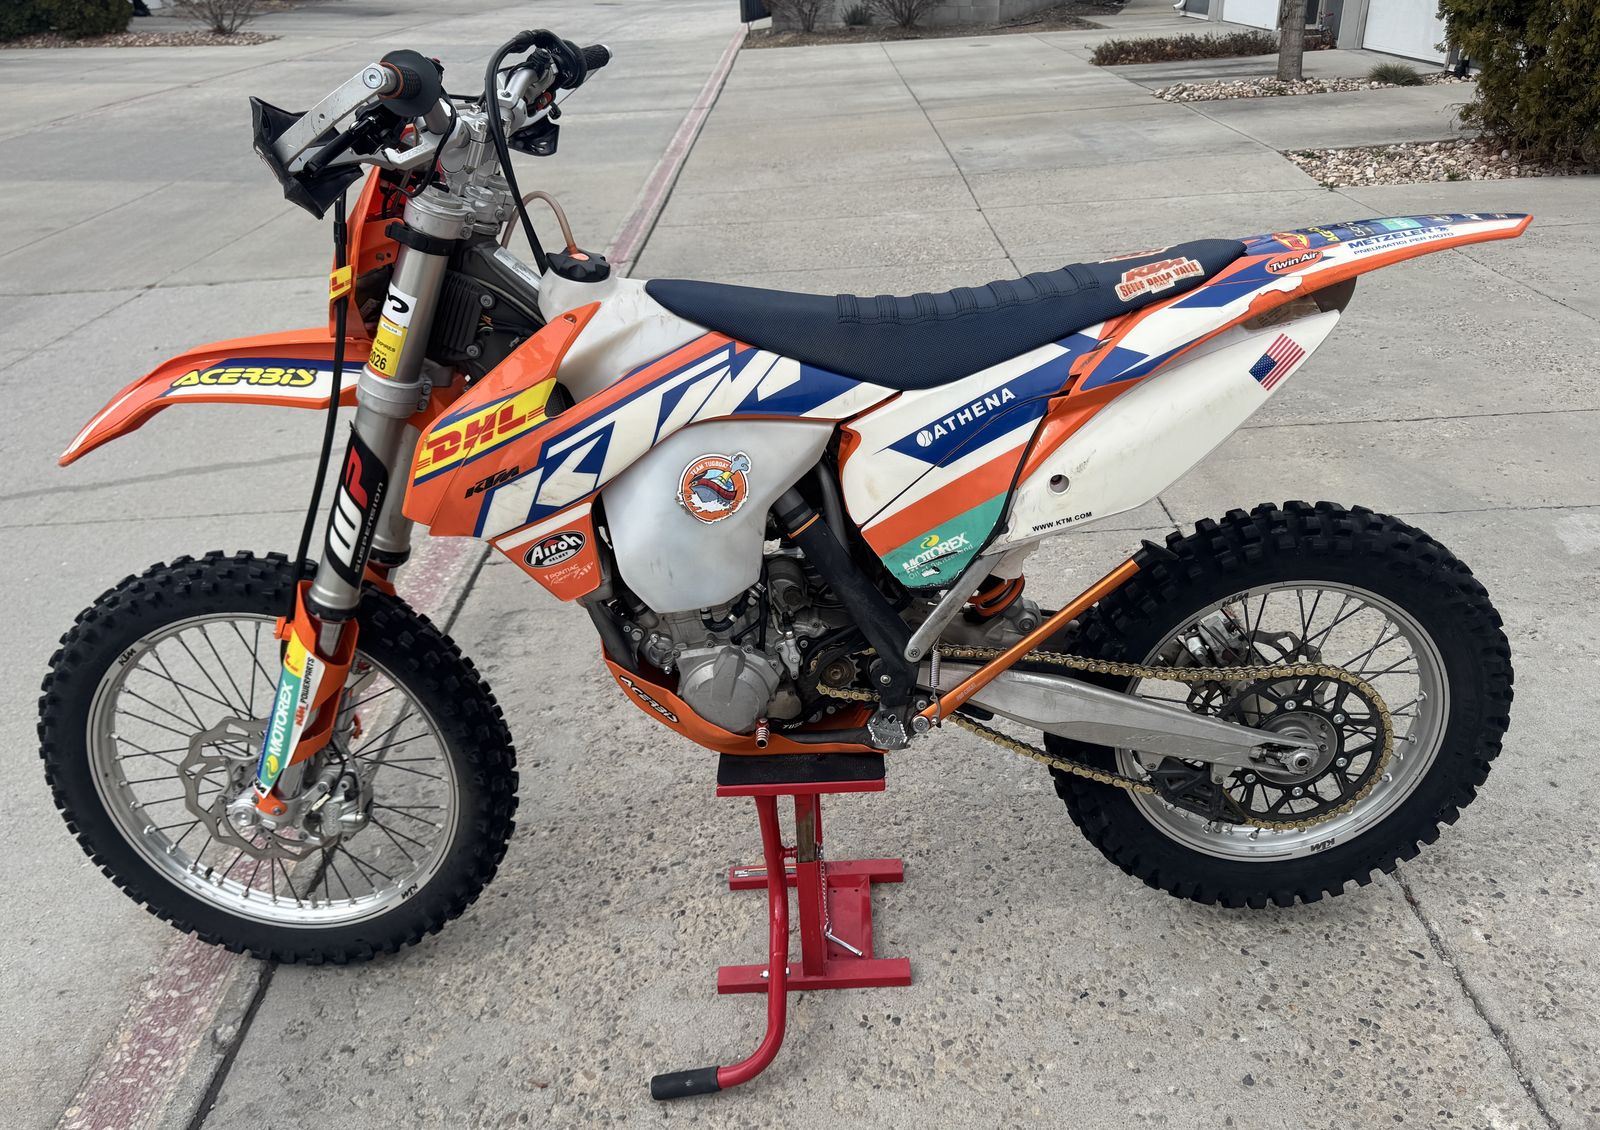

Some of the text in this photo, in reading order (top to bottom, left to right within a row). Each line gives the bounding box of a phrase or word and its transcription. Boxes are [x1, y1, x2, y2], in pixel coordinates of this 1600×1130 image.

[1349, 227, 1432, 249] METZELER
[1354, 240, 1408, 255] PNEUMATICI
[1428, 231, 1454, 240] MOTO
[1271, 251, 1318, 272] Twin Air
[1119, 261, 1200, 297] SELLE DALLA VALLE
[170, 366, 315, 387] ACERBIS
[933, 387, 1016, 440] ATHENA
[426, 404, 527, 465] DHL
[691, 461, 729, 476] TEAM TUGBOAT
[464, 465, 520, 499] KTM
[1032, 511, 1093, 532] WWW.KTM.COM
[530, 535, 582, 565] Airoh
[549, 551, 569, 562] HELMET
[902, 532, 970, 573] MOTOREX
[549, 564, 580, 580] PONTIAC
[118, 647, 136, 666] KTM
[269, 680, 294, 757] MOTOREX
[1310, 837, 1336, 852] KTM
[401, 882, 418, 900] KTM
